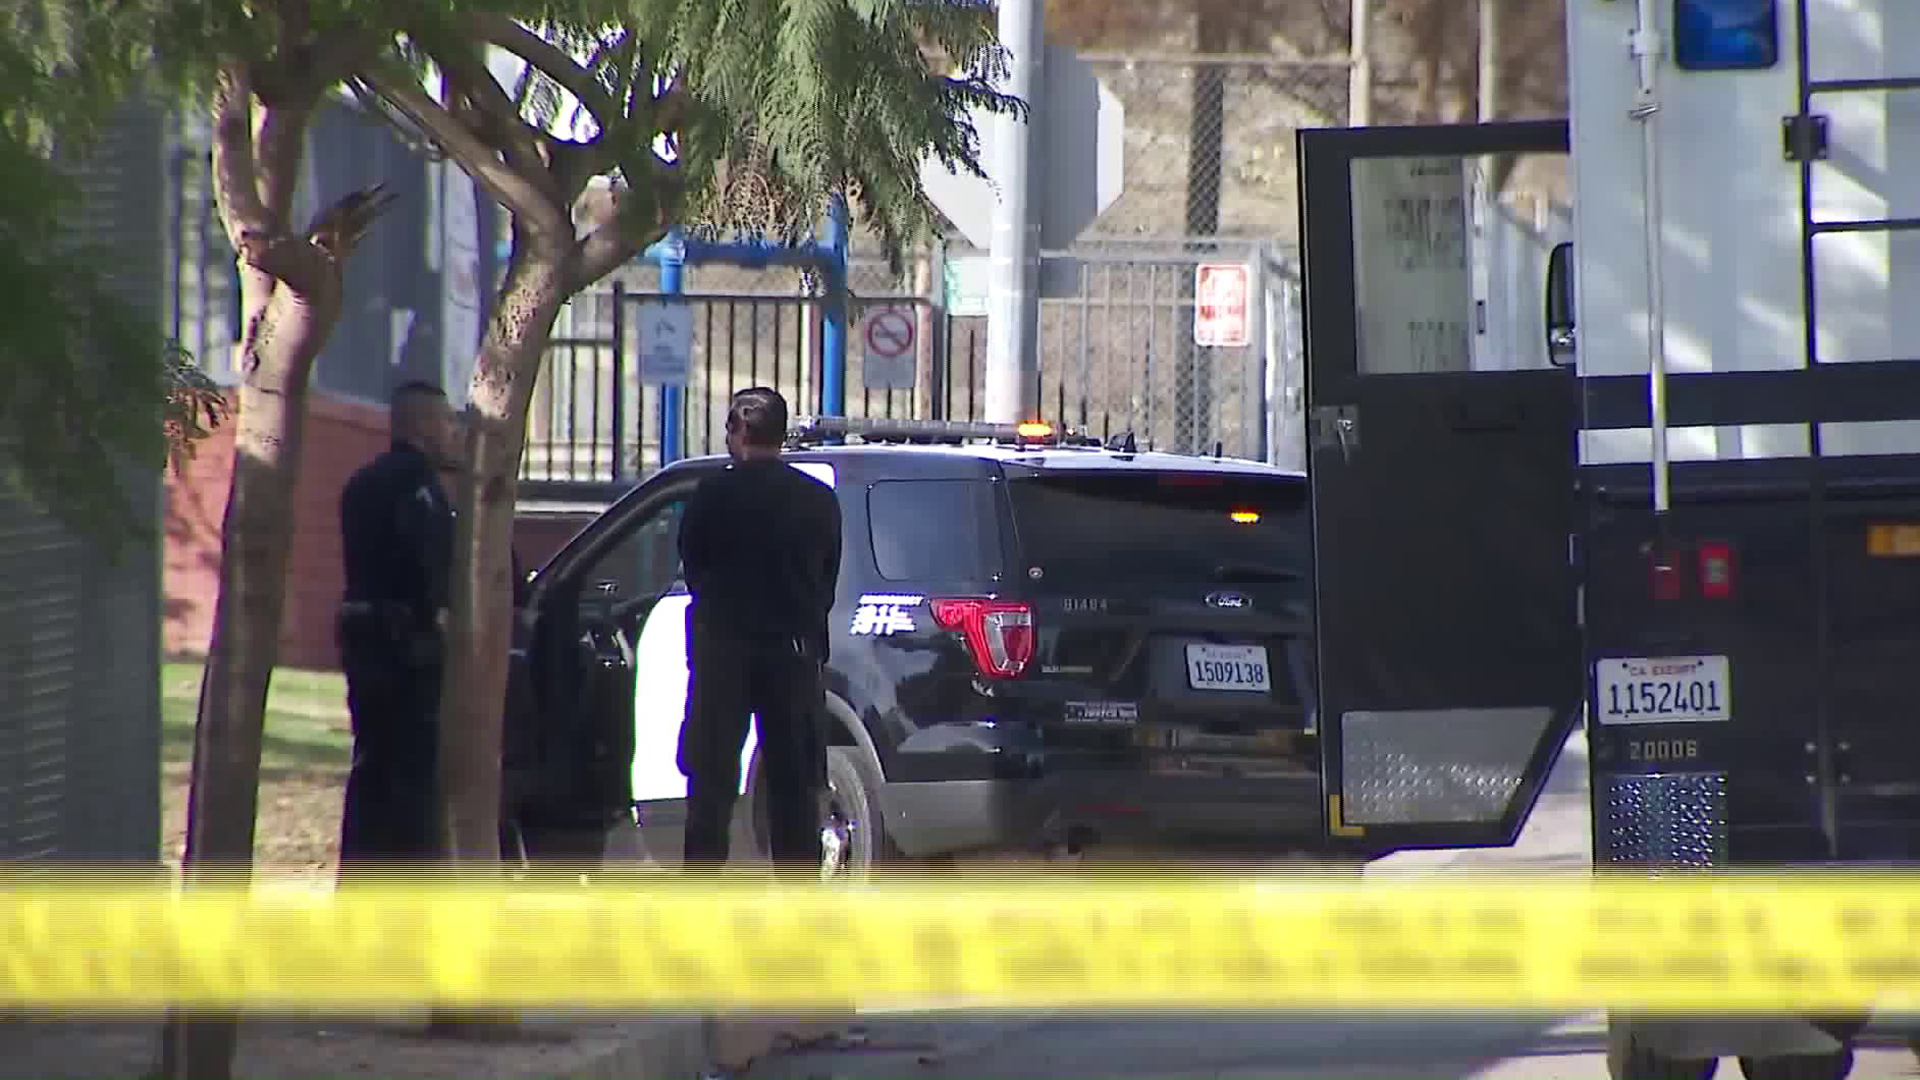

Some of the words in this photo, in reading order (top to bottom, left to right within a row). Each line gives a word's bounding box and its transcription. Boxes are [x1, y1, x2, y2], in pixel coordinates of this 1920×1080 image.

[1195, 661, 1264, 684] 1509138
[1630, 667, 1647, 676] CA
[1608, 680, 1721, 715] 1152401
[1630, 738, 1697, 761] 20006
